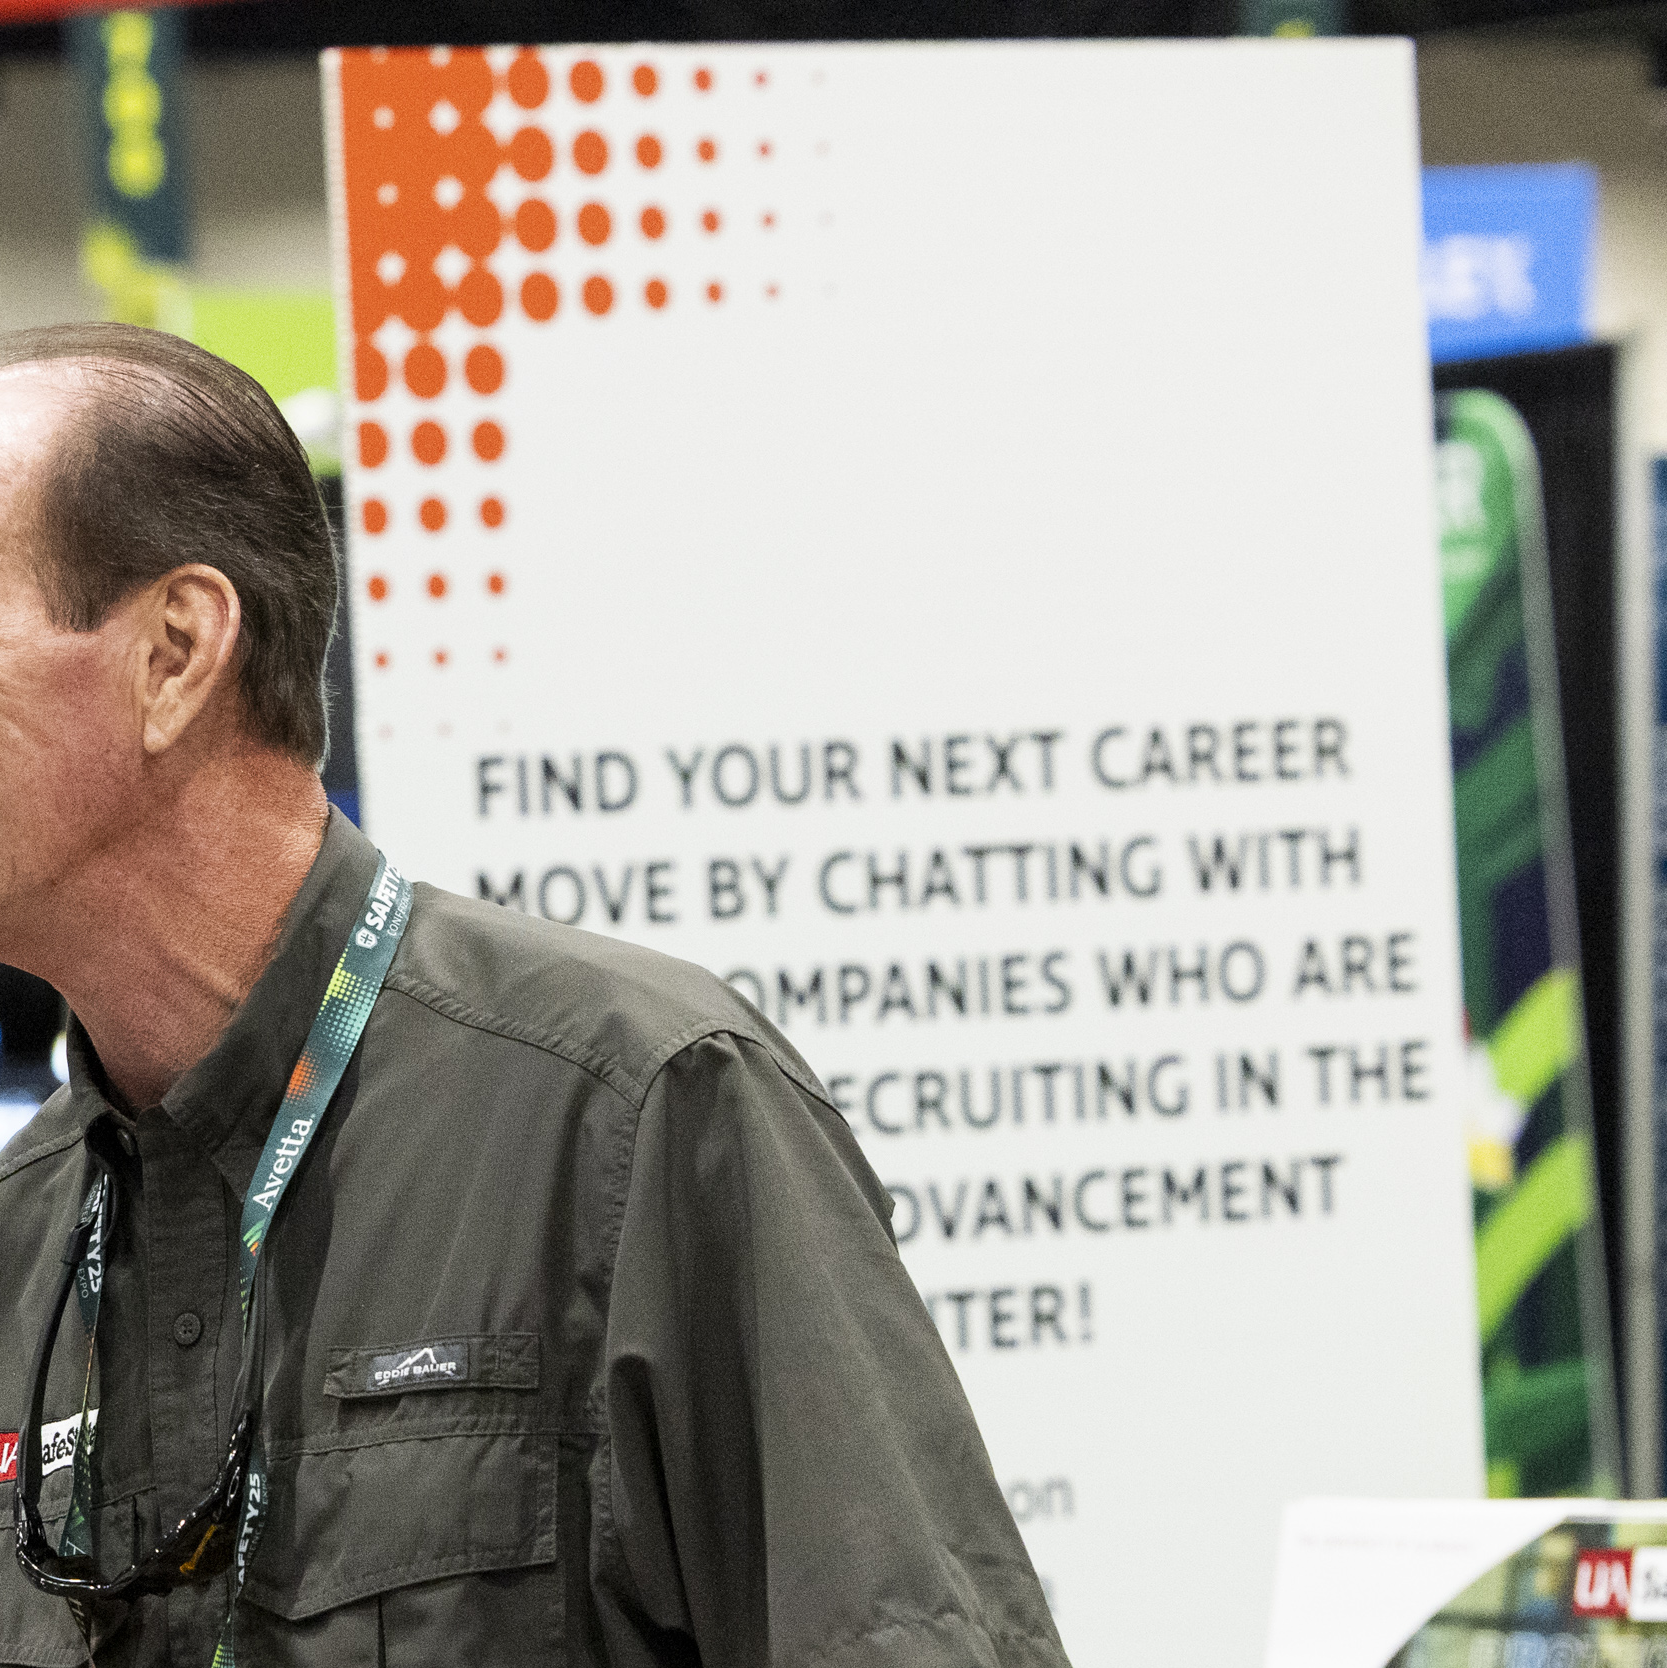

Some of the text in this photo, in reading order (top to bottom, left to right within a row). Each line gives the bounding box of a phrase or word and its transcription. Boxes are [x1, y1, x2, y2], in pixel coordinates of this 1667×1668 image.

[475, 717, 1352, 817] FIND YOUR NEXT CAREER
[478, 829, 1362, 924] MOVE BY CHATTING WITH
[727, 934, 1416, 1028] OMPANIES WHO ARE
[828, 1040, 1433, 1136] ECRUITING IN THE
[252, 1117, 313, 1212] Avetta
[896, 1156, 1343, 1245] DVANCEMENT
[77, 1267, 89, 1298] EXPO
[374, 1361, 457, 1381] EDDIE BAUER
